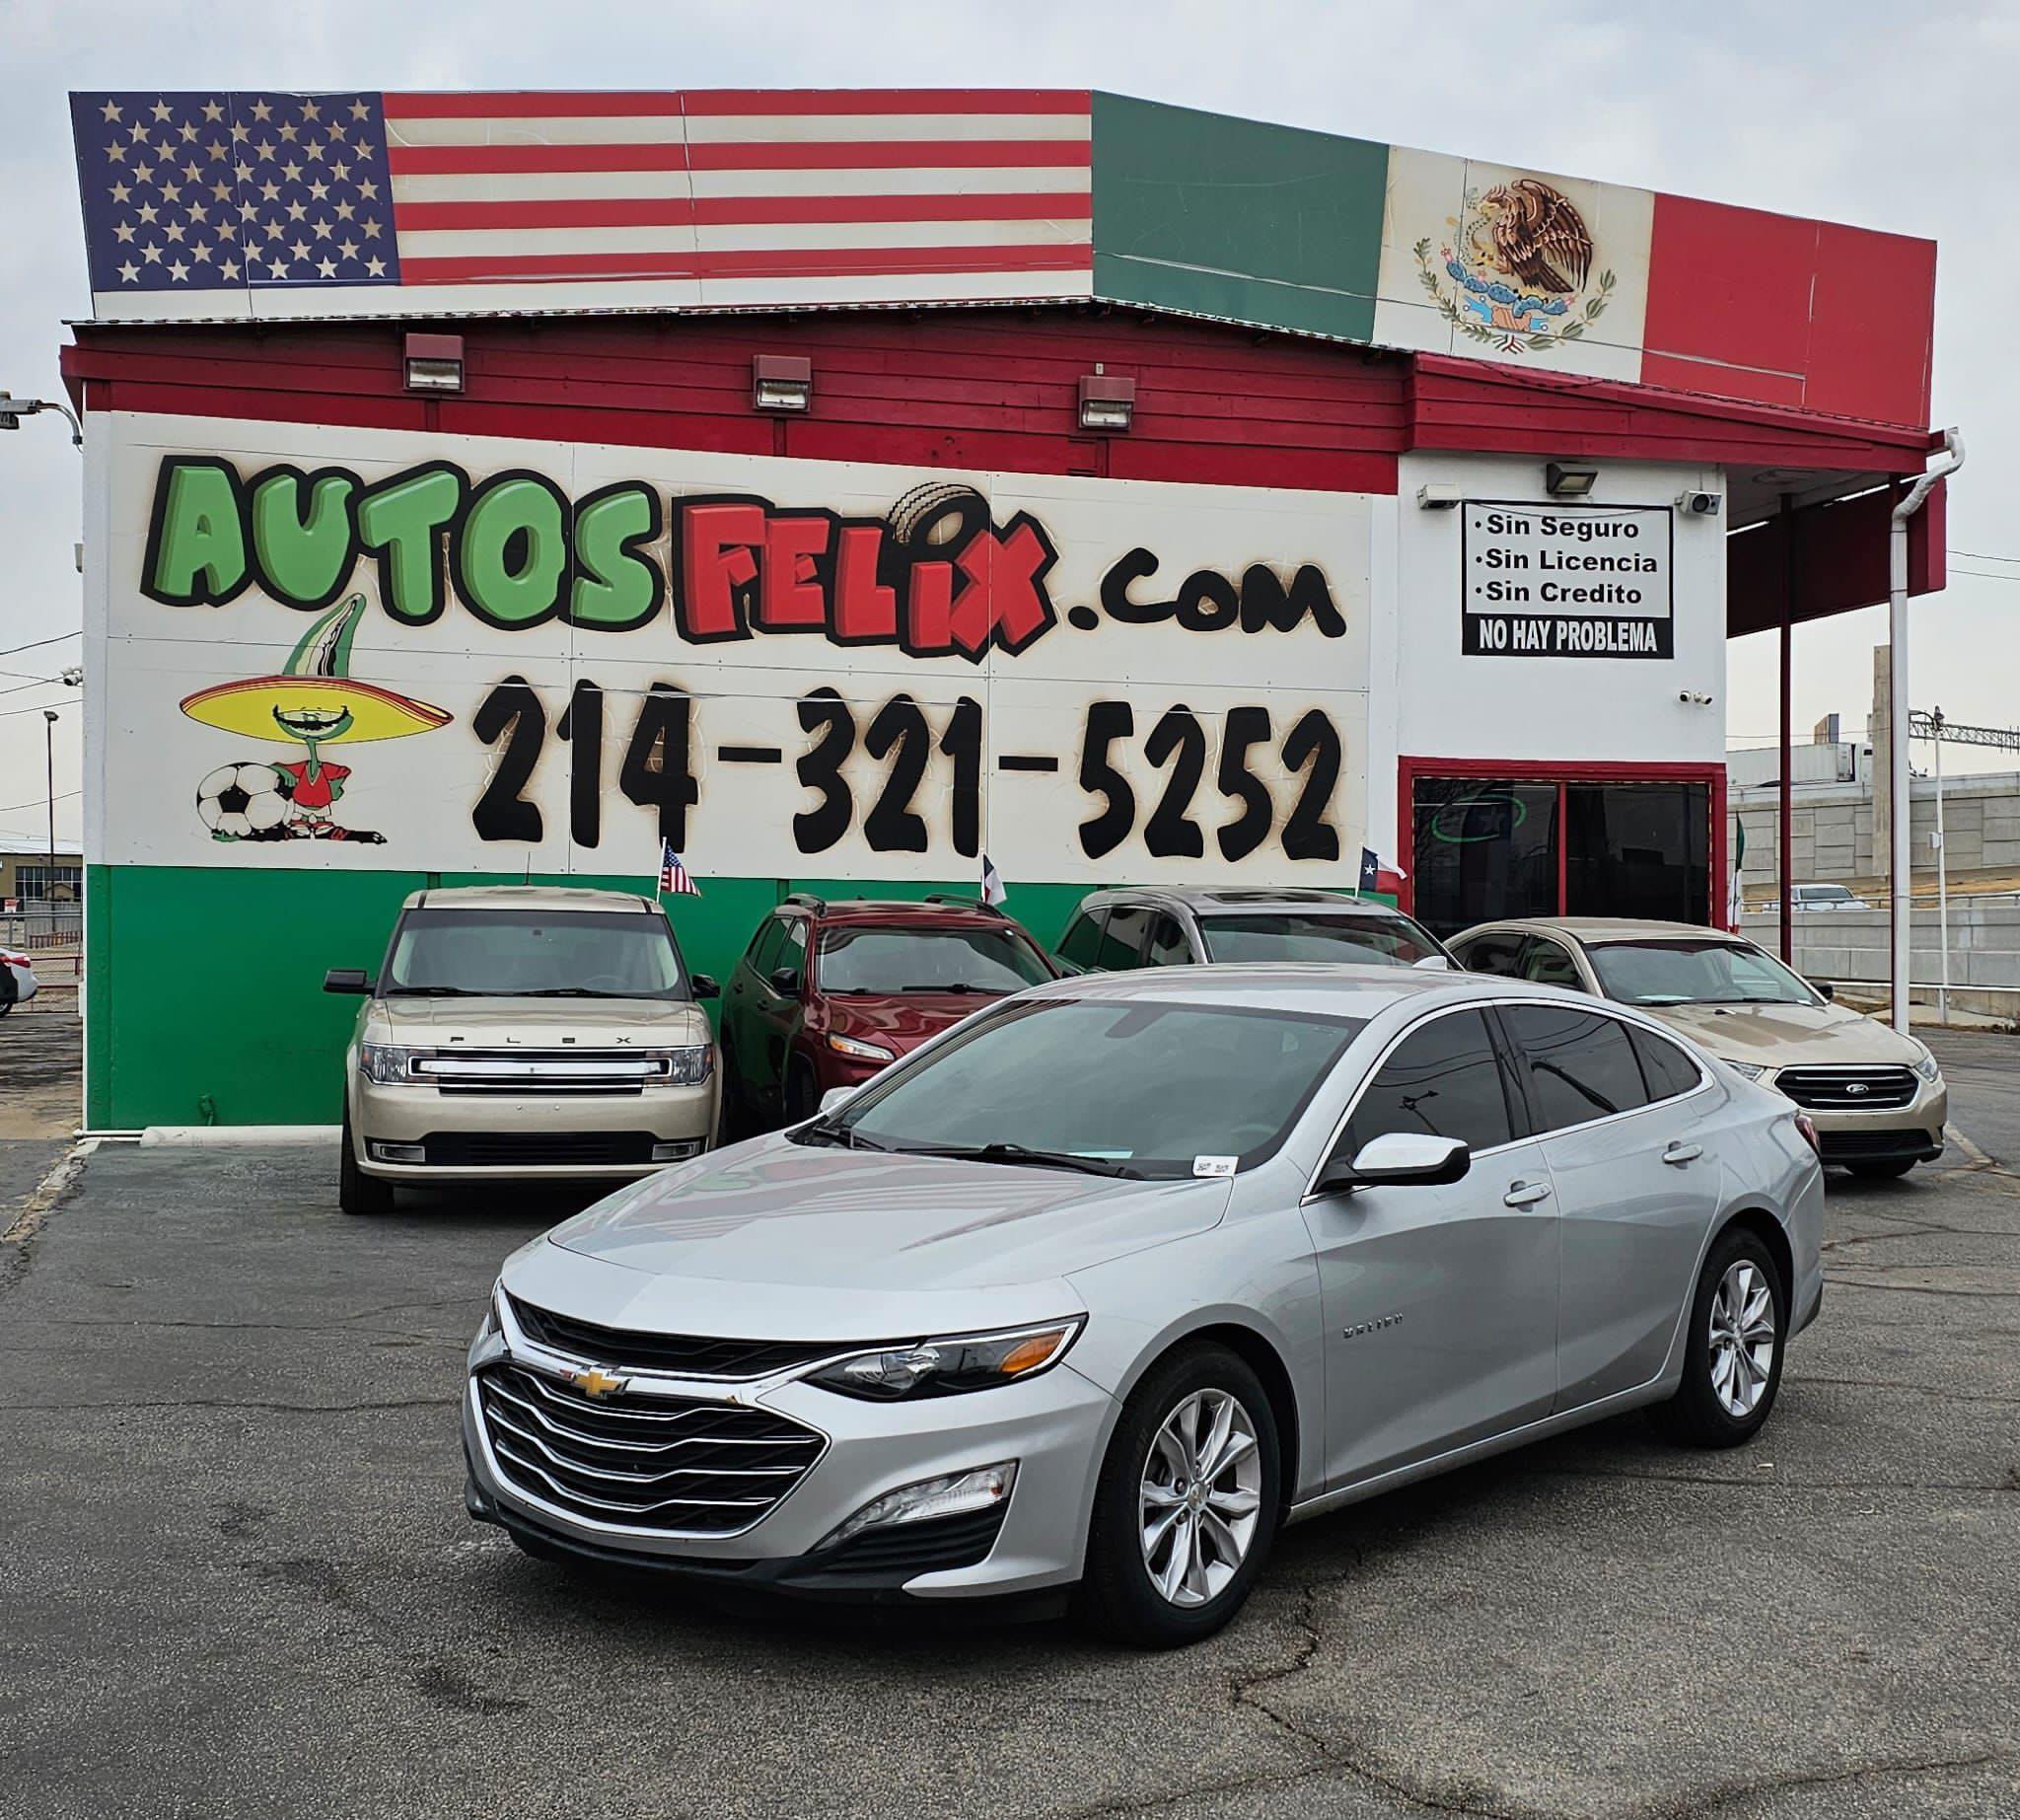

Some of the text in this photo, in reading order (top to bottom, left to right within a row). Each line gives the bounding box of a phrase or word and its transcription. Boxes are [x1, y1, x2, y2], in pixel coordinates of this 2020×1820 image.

[1486, 515, 1639, 542] Sin Seguro
[1485, 548, 1658, 572] Sin Licencia
[1485, 581, 1642, 604] Sin Credito
[1479, 619, 1657, 652] NO HAY PROBLEMA
